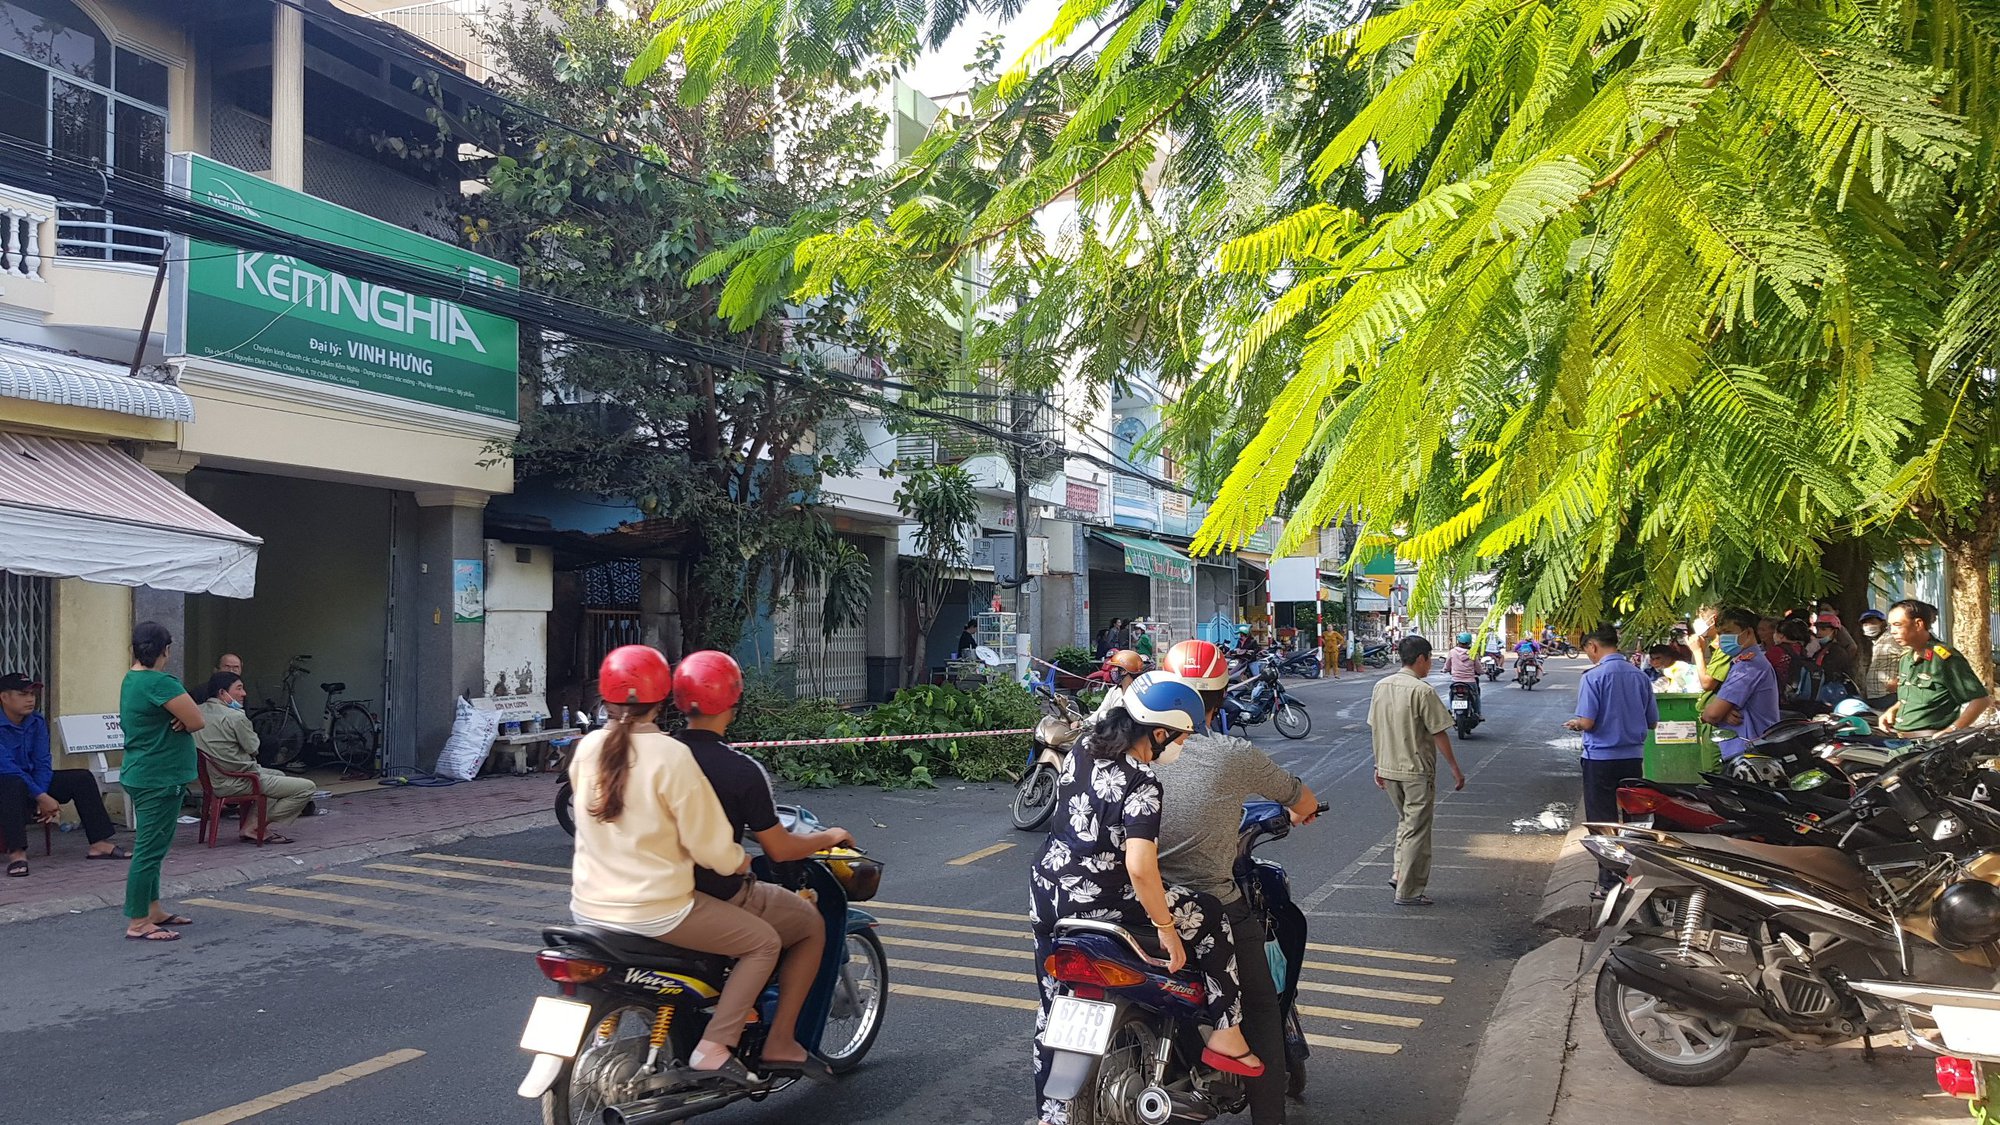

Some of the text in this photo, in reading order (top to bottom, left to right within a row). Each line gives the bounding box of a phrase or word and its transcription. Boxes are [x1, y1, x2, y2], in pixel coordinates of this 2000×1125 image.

[309, 338, 433, 376] Đại lý: VINH HƯNG
[624, 967, 682, 988] Wave
[1159, 979, 1196, 995] Future
[1060, 1001, 1106, 1027] 67-F6
